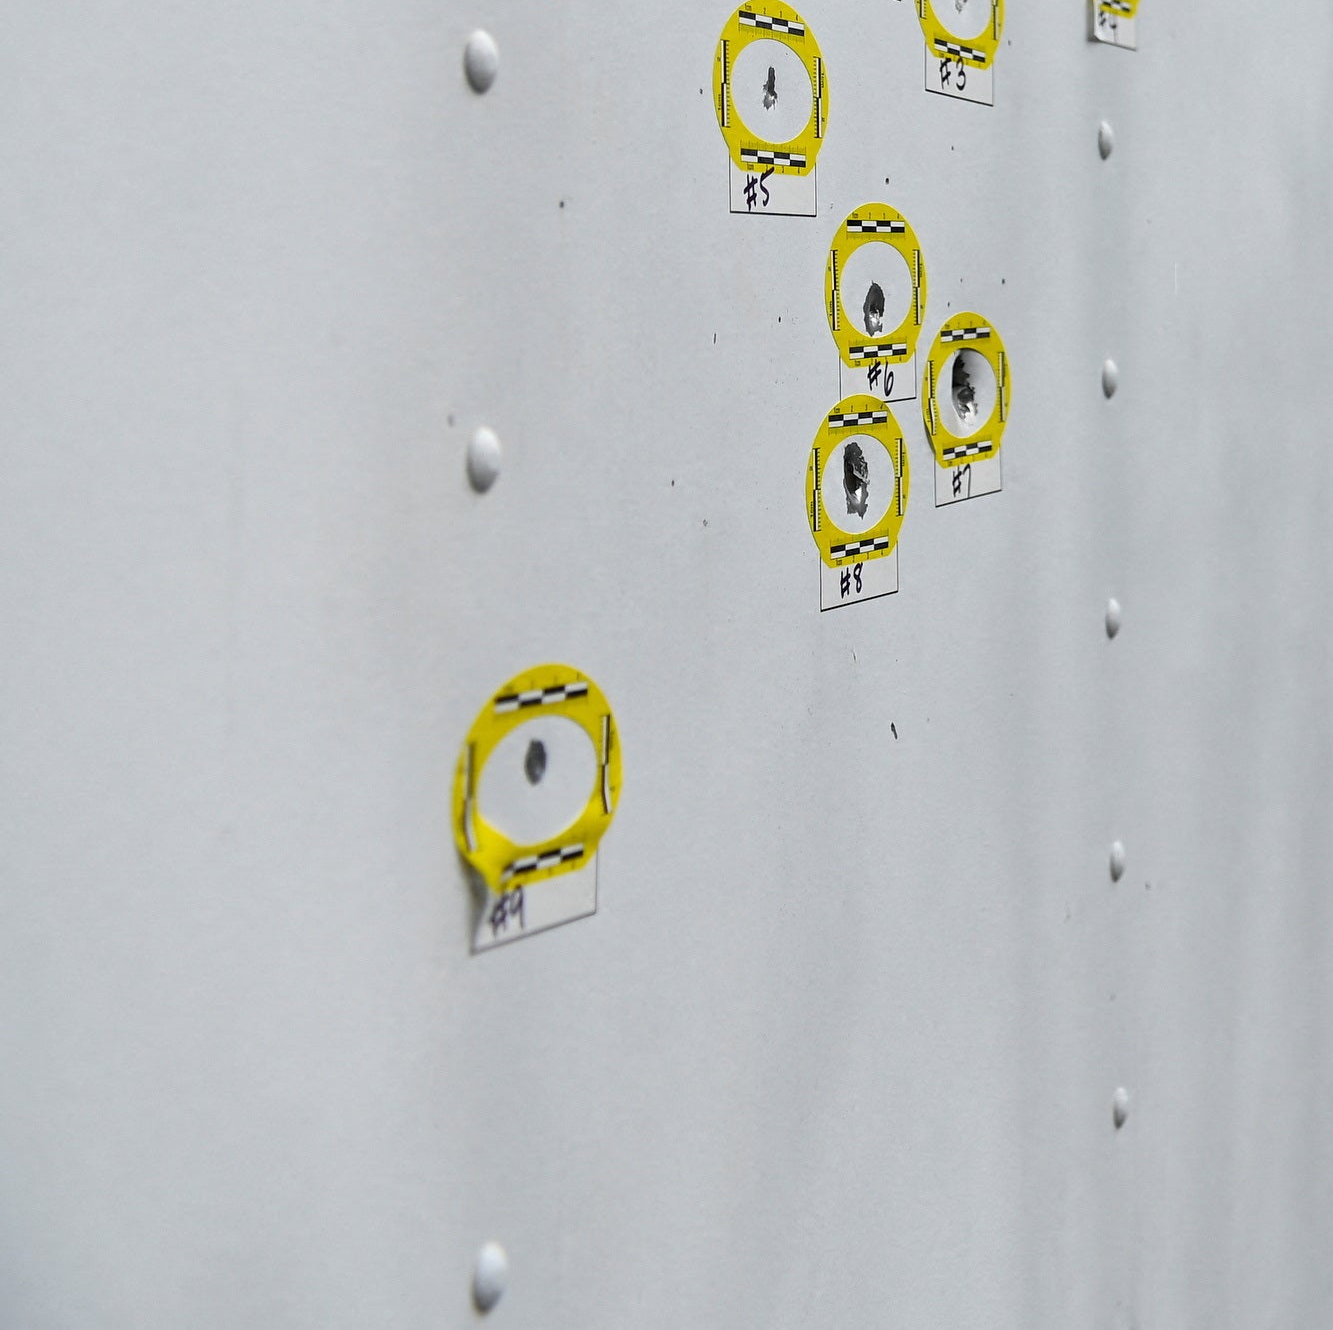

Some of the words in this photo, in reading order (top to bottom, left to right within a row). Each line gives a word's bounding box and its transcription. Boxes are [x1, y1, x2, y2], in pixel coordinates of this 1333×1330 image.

[939, 57, 967, 91] #3
[743, 167, 775, 211] #5
[867, 356, 894, 397] #6
[951, 463, 972, 499] #7
[840, 562, 864, 599] #8
[488, 884, 525, 937] #9
